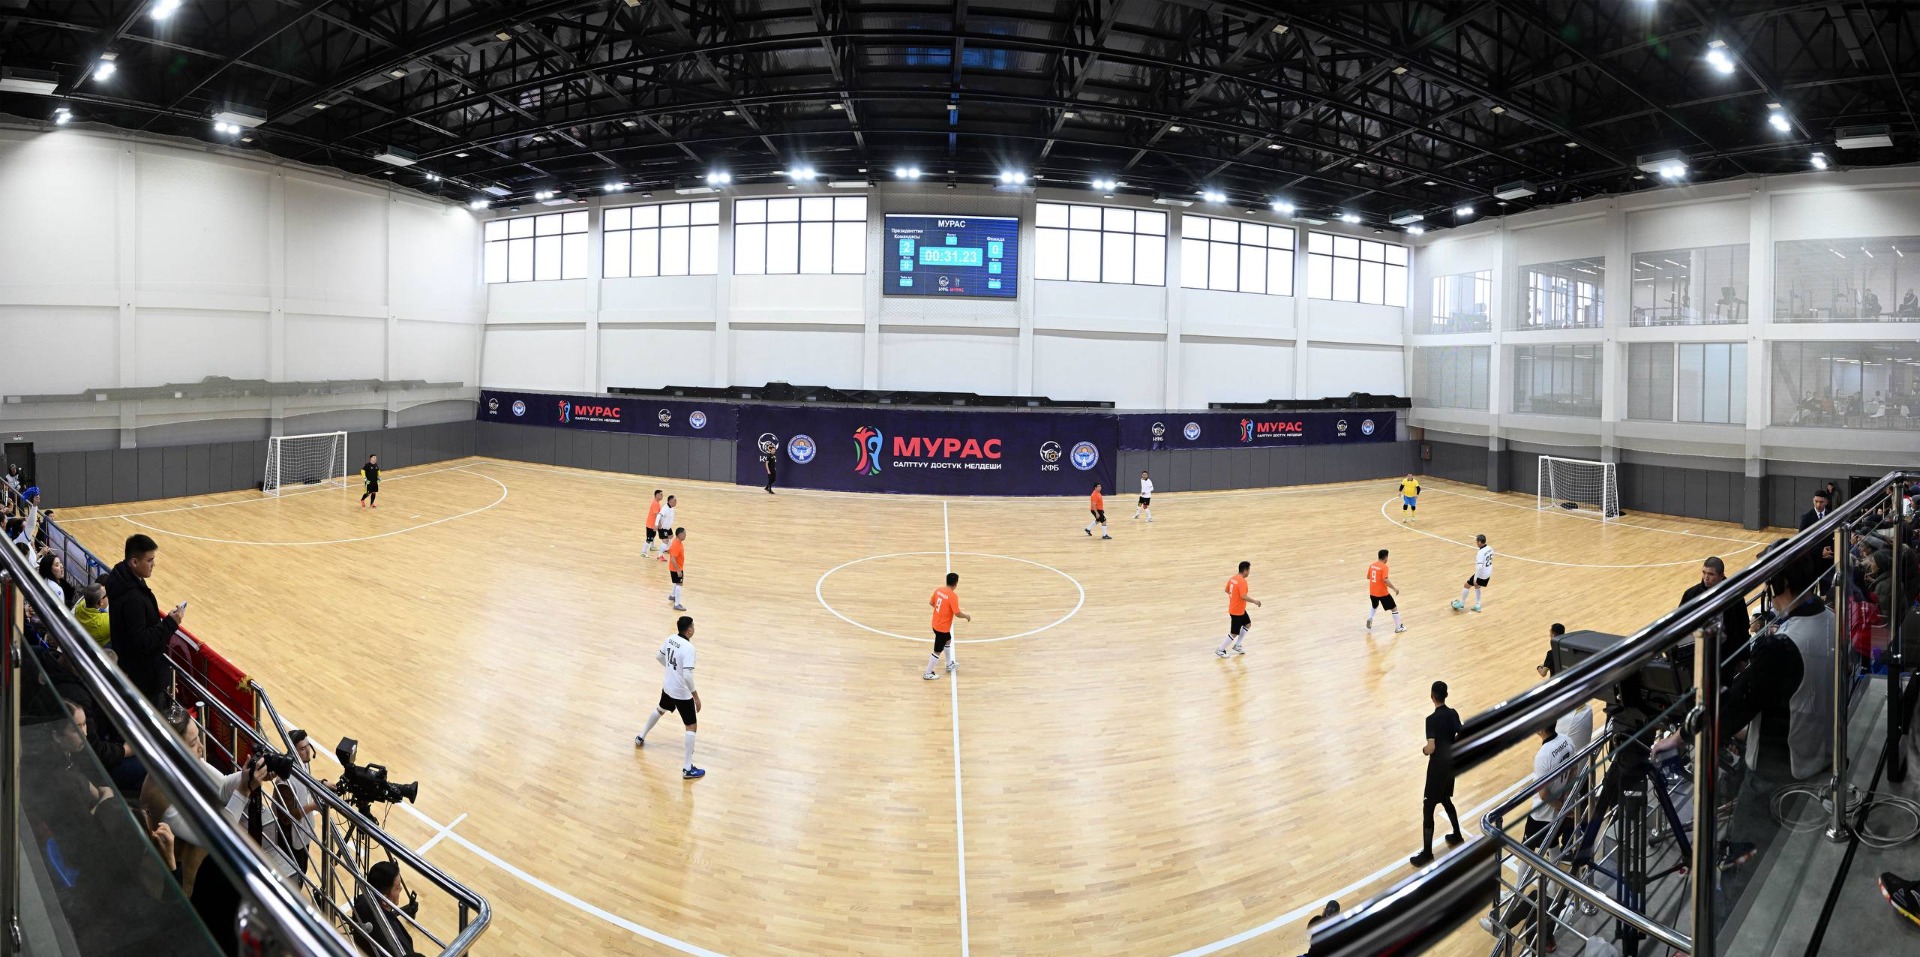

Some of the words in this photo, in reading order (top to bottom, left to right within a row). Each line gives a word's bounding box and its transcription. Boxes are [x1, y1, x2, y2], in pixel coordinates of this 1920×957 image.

[938, 220, 966, 228] МУРАС
[903, 243, 911, 253] 2
[992, 246, 999, 255] 0
[925, 250, 977, 263] 00:31.23
[575, 405, 621, 418] МУРАС
[1257, 421, 1303, 432] МУРАС
[893, 436, 1002, 459] МУРАС
[893, 461, 929, 469] САЛТТУУ
[930, 462, 962, 470] ДОСТУК
[964, 463, 1002, 471] МЕЛДЕШИ
[1371, 570, 1376, 583] 9
[936, 598, 942, 612] 9
[667, 648, 677, 670] 14
